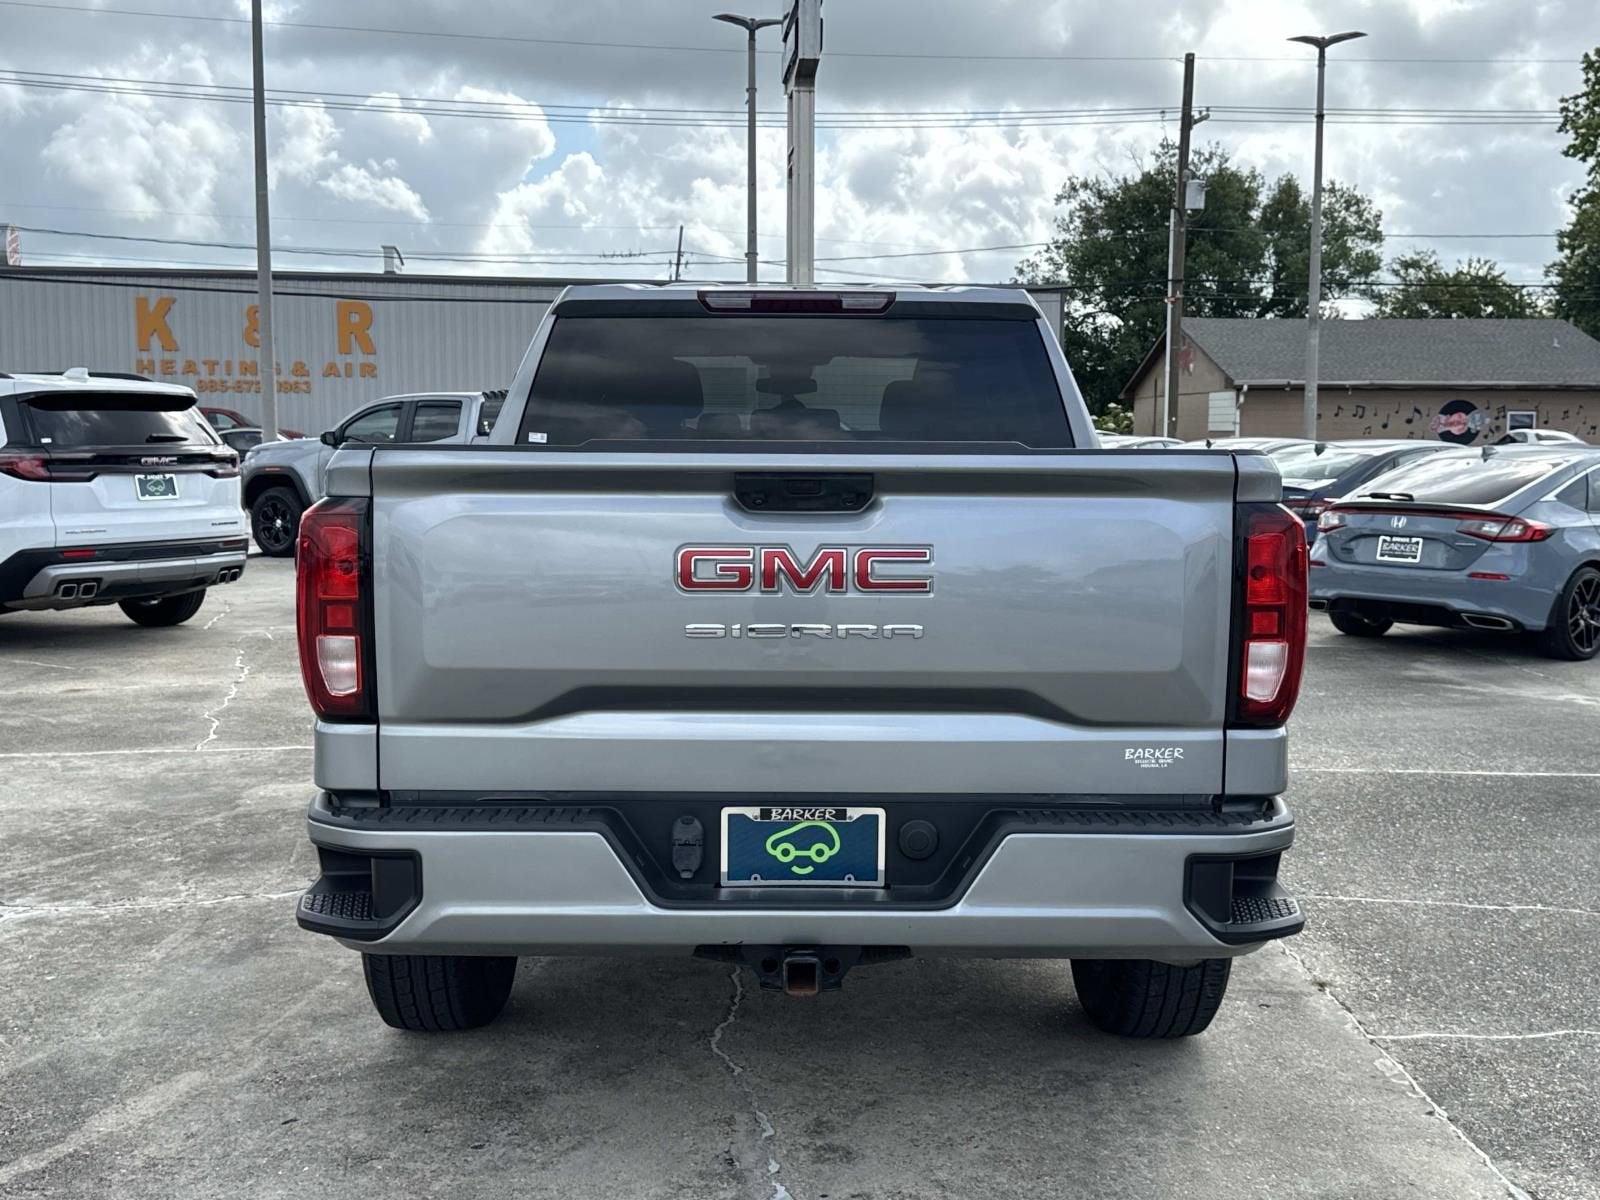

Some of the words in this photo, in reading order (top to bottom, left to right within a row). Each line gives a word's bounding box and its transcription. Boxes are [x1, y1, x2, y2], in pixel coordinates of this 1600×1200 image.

[135, 297, 179, 351] K
[336, 300, 376, 354] R
[292, 361, 310, 376] &
[322, 362, 377, 378] AIR
[677, 546, 932, 593] GMC
[684, 623, 925, 640] SIERRA
[1124, 747, 1185, 760] BARKER
[770, 808, 837, 821] BARKER
